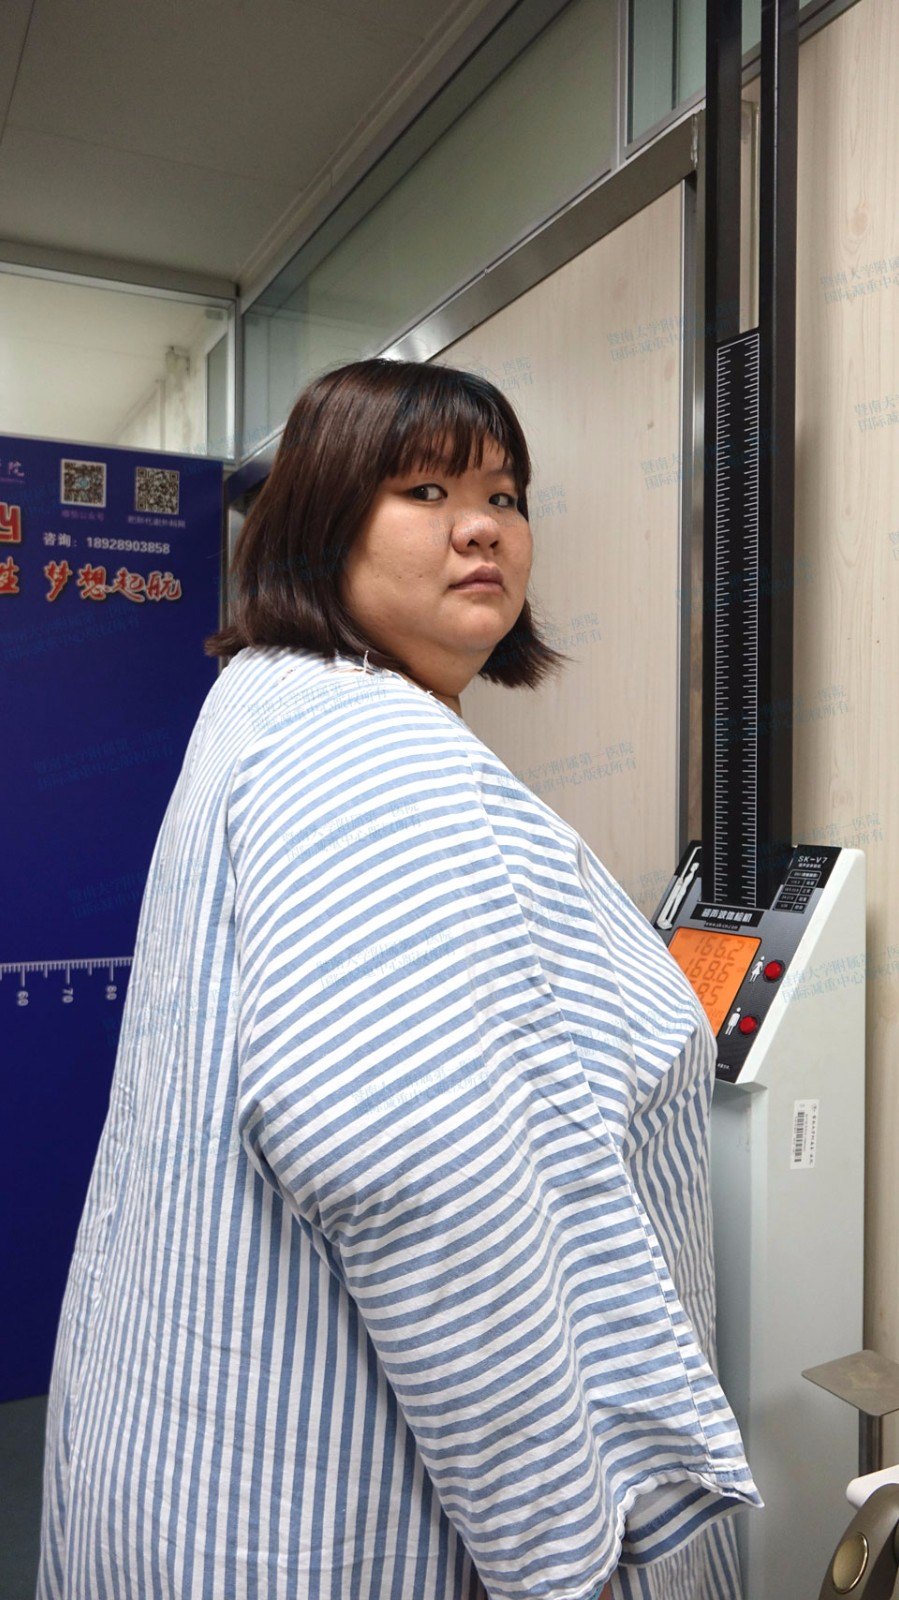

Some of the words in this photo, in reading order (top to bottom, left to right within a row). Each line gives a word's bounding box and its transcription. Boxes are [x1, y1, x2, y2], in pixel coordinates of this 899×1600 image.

[86, 536, 170, 555] 18928903858
[44, 559, 183, 603] 梦想起航
[798, 855, 828, 864] SK-V7
[695, 936, 745, 961] 166.2
[685, 958, 735, 984] 168.6
[62, 988, 74, 1004] 70
[106, 985, 118, 1001] 80
